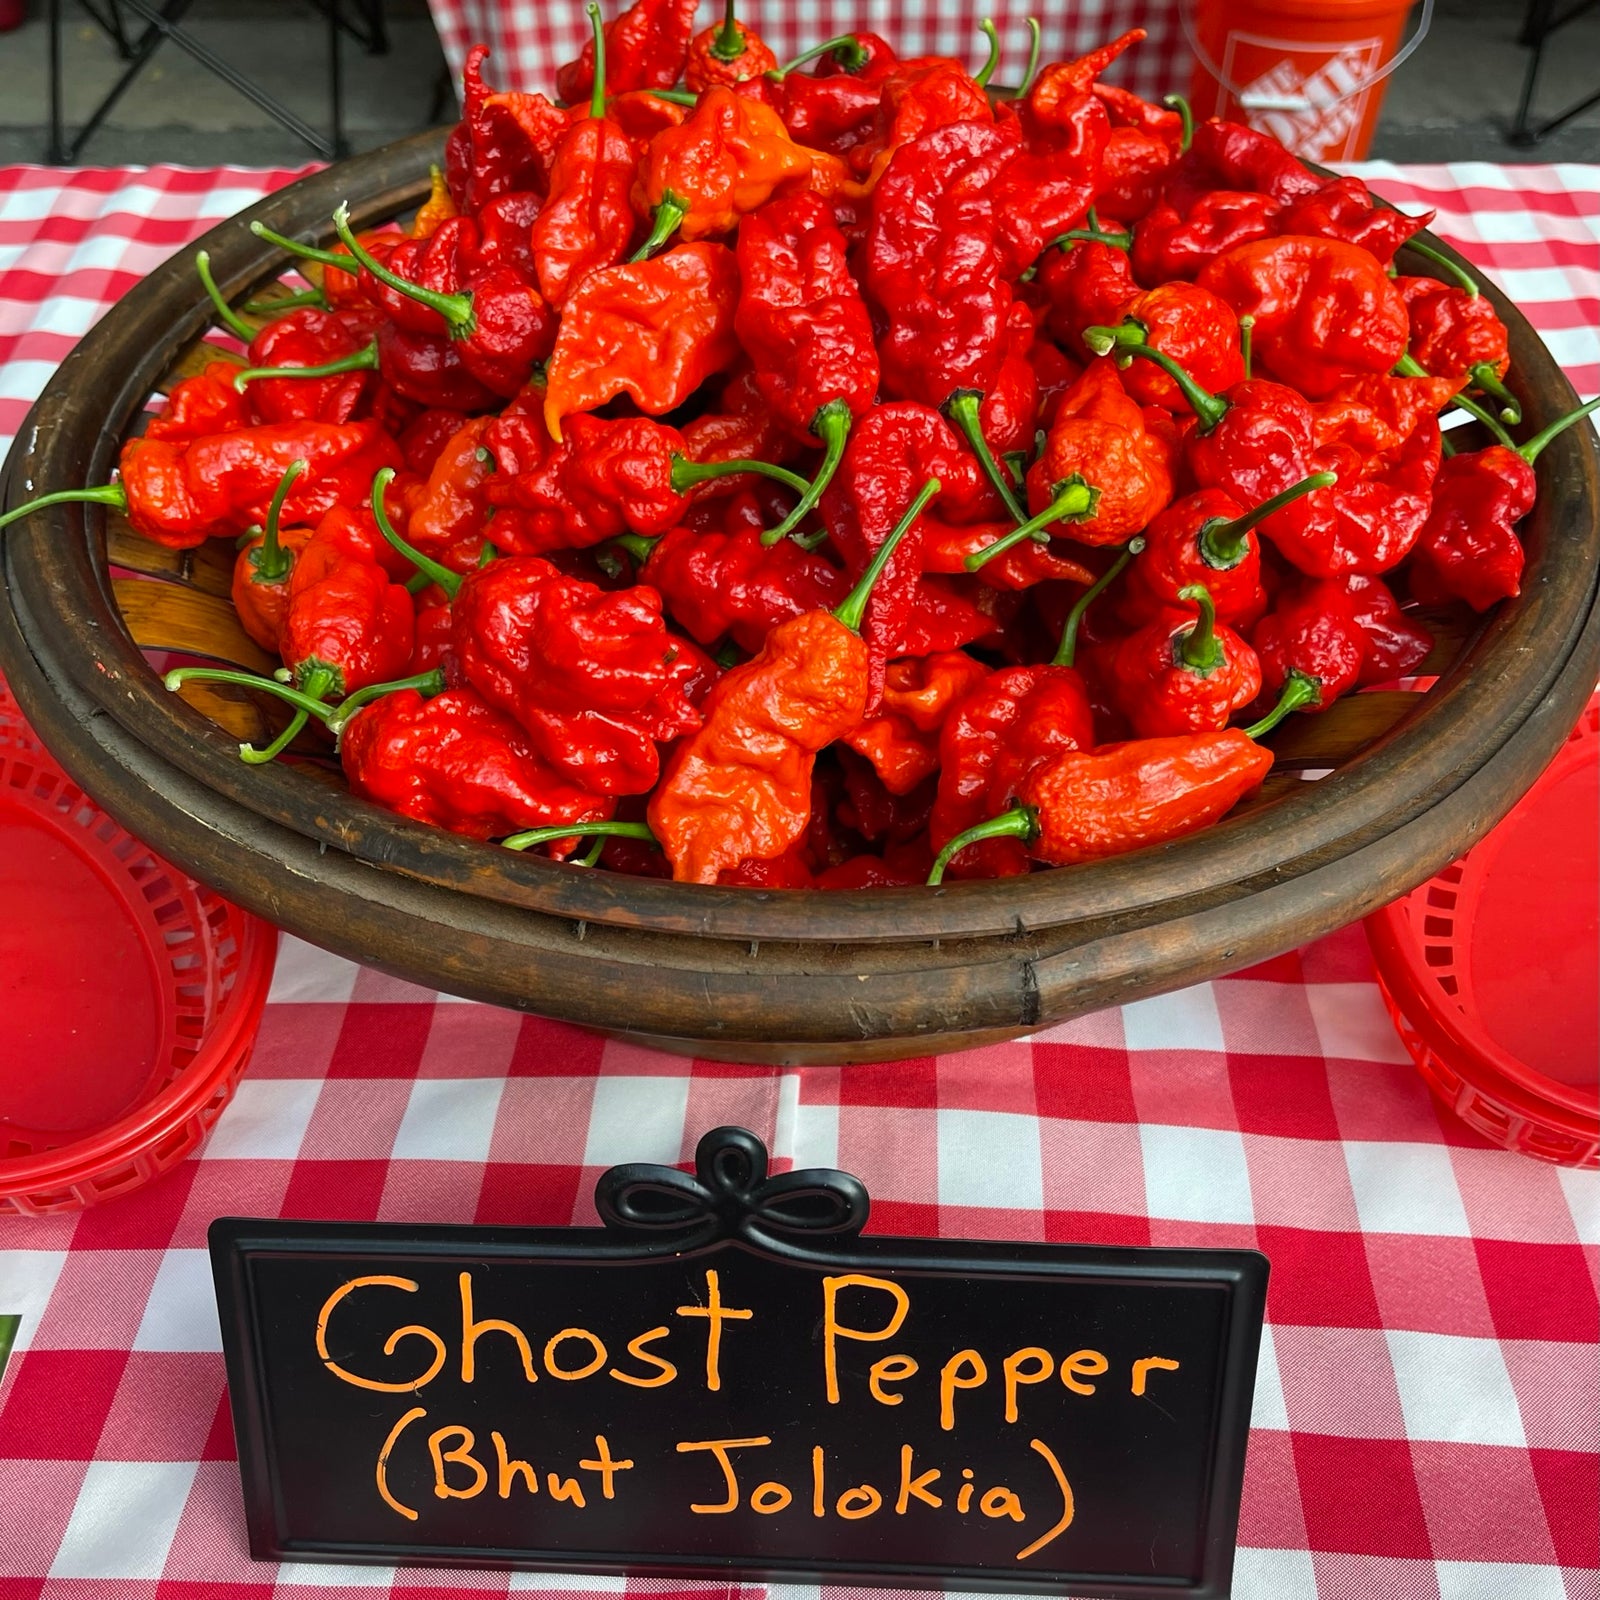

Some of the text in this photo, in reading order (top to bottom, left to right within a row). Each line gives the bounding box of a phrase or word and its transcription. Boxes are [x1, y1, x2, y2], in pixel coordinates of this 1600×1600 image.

[1249, 47, 1375, 153] OME
[315, 1271, 1180, 1431] Ghost Pepper
[376, 1407, 1075, 1560] (Bhut Jolokia)
